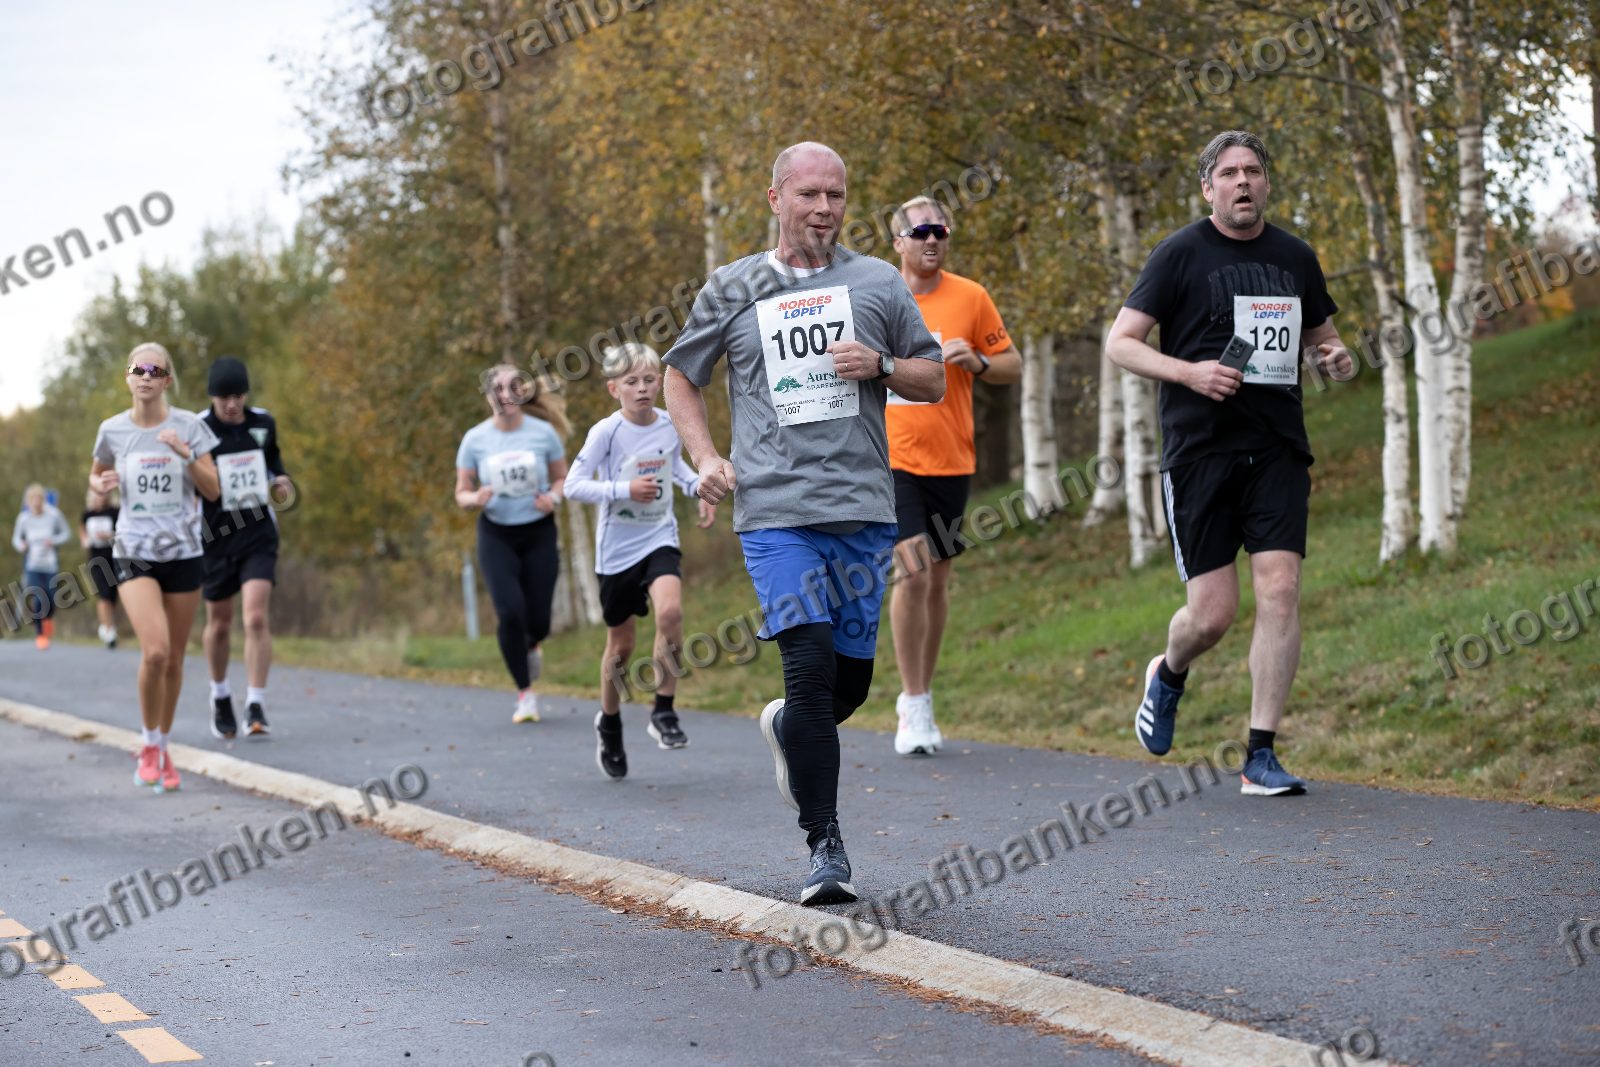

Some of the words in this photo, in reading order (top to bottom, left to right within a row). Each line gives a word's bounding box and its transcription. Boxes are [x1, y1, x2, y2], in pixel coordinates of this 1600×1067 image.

[778, 295, 833, 311] NORGES
[1250, 303, 1292, 311] NORGES
[783, 305, 825, 319] LØPET
[1254, 311, 1286, 319] LØPET
[771, 321, 845, 360] 1007
[1249, 326, 1290, 352] 120
[1264, 363, 1296, 376] Aurskog
[784, 405, 801, 415] 1007
[828, 400, 844, 409] 1007
[138, 474, 171, 493] 942
[229, 470, 257, 489] 212
